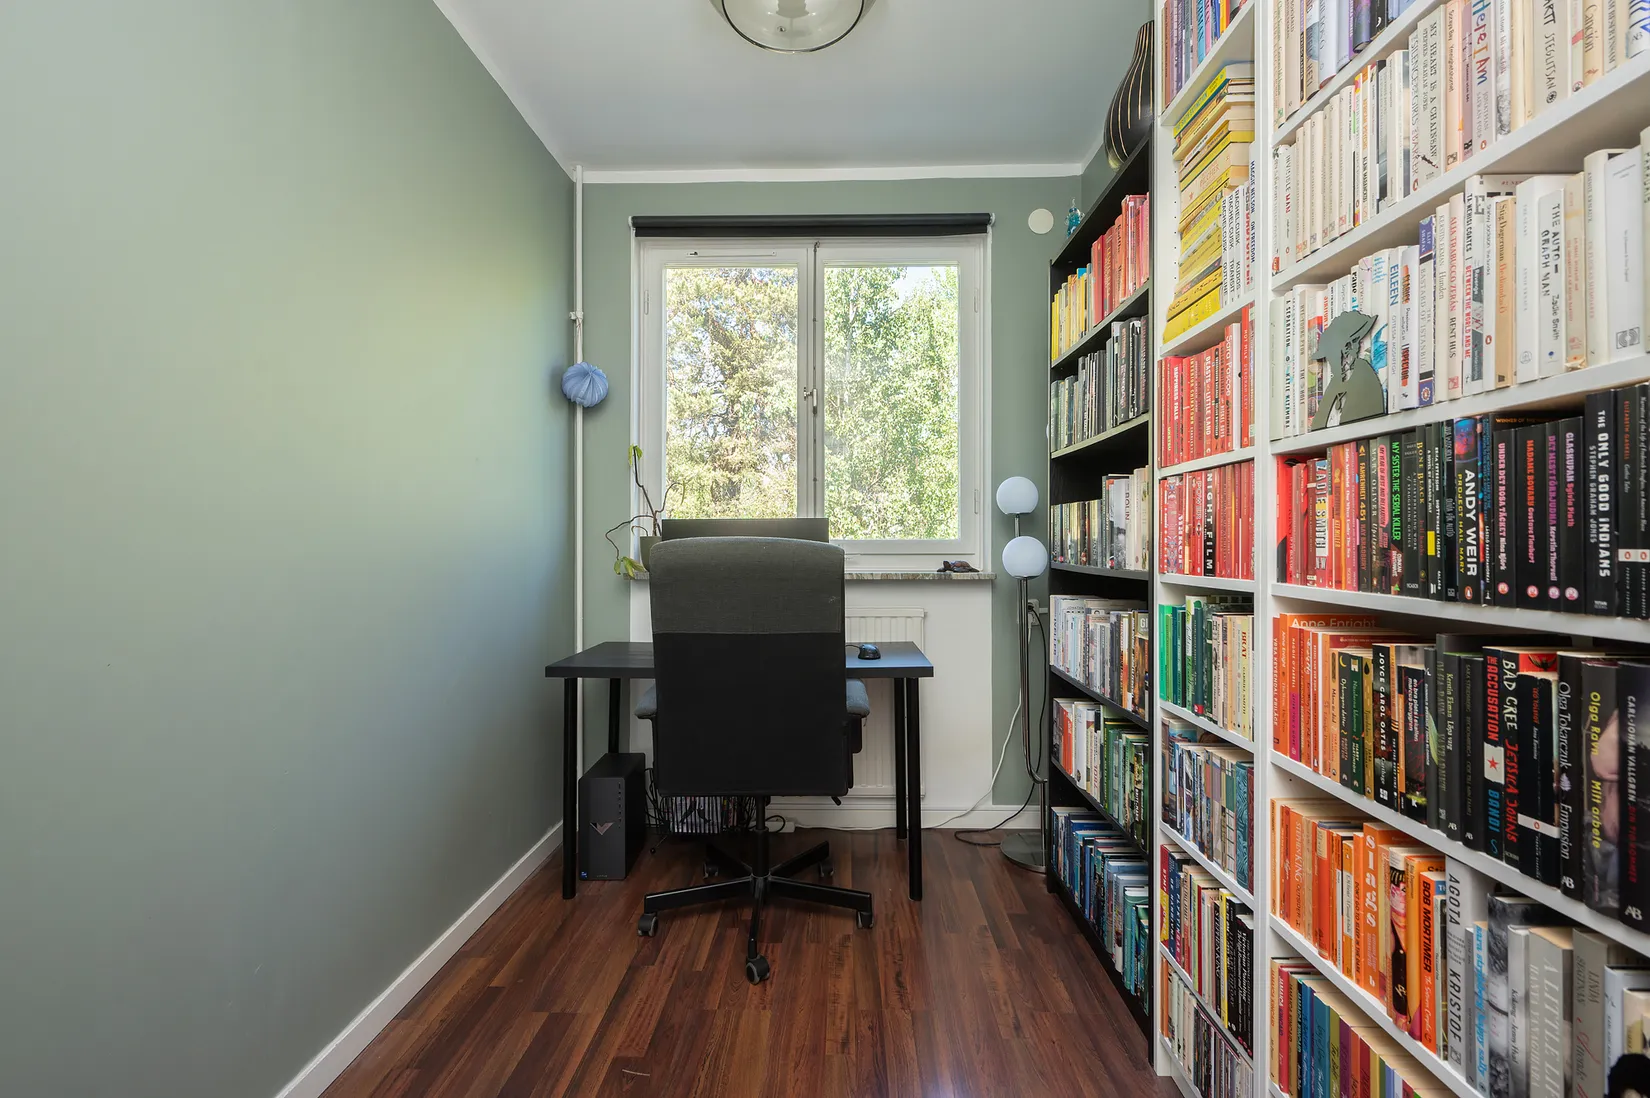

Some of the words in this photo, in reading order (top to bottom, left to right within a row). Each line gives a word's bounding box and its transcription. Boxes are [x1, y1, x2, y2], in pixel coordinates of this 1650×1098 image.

[1430, 22, 1437, 38] MY
[1584, 5, 1600, 53] Canción
[1476, 57, 1490, 85] Am
[1545, 33, 1556, 89] STEGLITSAN
[1430, 81, 1437, 91] IS
[1449, 216, 1457, 235] ALIA
[1497, 204, 1507, 219] Stig
[1552, 203, 1561, 227] THE
[1497, 219, 1507, 261] Dagerman
[1541, 230, 1550, 268] GRAPH
[1449, 237, 1457, 283] TRABUCCO
[1390, 265, 1398, 306] EILEEN
[1438, 272, 1446, 300] Hunden
[1420, 310, 1427, 321] OF
[1552, 294, 1560, 316] Zadie
[1552, 319, 1560, 340] Smith
[1465, 349, 1471, 359] ME
[1598, 410, 1606, 428] THE
[1392, 442, 1399, 454] MY
[1498, 443, 1506, 468] UNDER
[1548, 435, 1556, 451] DET
[1566, 432, 1574, 482] GLASKUPAN
[1597, 433, 1609, 468] ONLY
[1316, 464, 1327, 504] ZADIE
[1417, 473, 1425, 504] BLACK
[1498, 470, 1506, 485] DET
[1527, 475, 1535, 506] BOVARY
[1598, 474, 1609, 511] GOOD
[1392, 494, 1401, 517] SERIAL
[1465, 469, 1476, 521] ANDY
[1498, 486, 1506, 506] ROSA
[1549, 476, 1558, 525] FÖRBJUDNA
[1566, 483, 1574, 505] Sylvia
[1589, 482, 1597, 515] GRAHAM
[1315, 510, 1327, 549] SMITH
[1392, 518, 1401, 540] KILLER
[1499, 507, 1508, 536] TÄCKET
[1466, 527, 1477, 576] WEIR
[1549, 526, 1557, 551] Kerstin
[1598, 517, 1610, 577] INDIANS
[1502, 659, 1517, 690] BAD
[1487, 666, 1499, 741] ACCUSATION
[1558, 682, 1571, 710] Olga
[1589, 691, 1601, 721] Olga
[1446, 721, 1454, 736] Löpa
[1503, 696, 1518, 731] CREE
[1626, 695, 1636, 753] CARL-JOHAN
[1559, 713, 1571, 769] Tokarczuk
[1590, 726, 1601, 756] Ravn
[1504, 739, 1519, 793] JESSICA
[1627, 755, 1637, 801] VALLGREN
[1591, 780, 1602, 805] Mitt
[1488, 789, 1501, 832] BANDI
[1504, 799, 1518, 843] JOHNS
[1592, 807, 1602, 848] arbete
[1294, 855, 1303, 882] KING
[1423, 880, 1431, 905] BOB
[1448, 873, 1460, 926] AGOTA
[1423, 907, 1432, 973] MORTIMER
[1474, 926, 1484, 952] sara
[1543, 958, 1559, 974] A
[1449, 968, 1462, 1042] KRISTOF
[1474, 1013, 1486, 1046] happy
[1543, 980, 1560, 1062] LITTLE
[1530, 1009, 1540, 1087] YANAGIHARA
[1543, 1062, 1560, 1098] LIF
